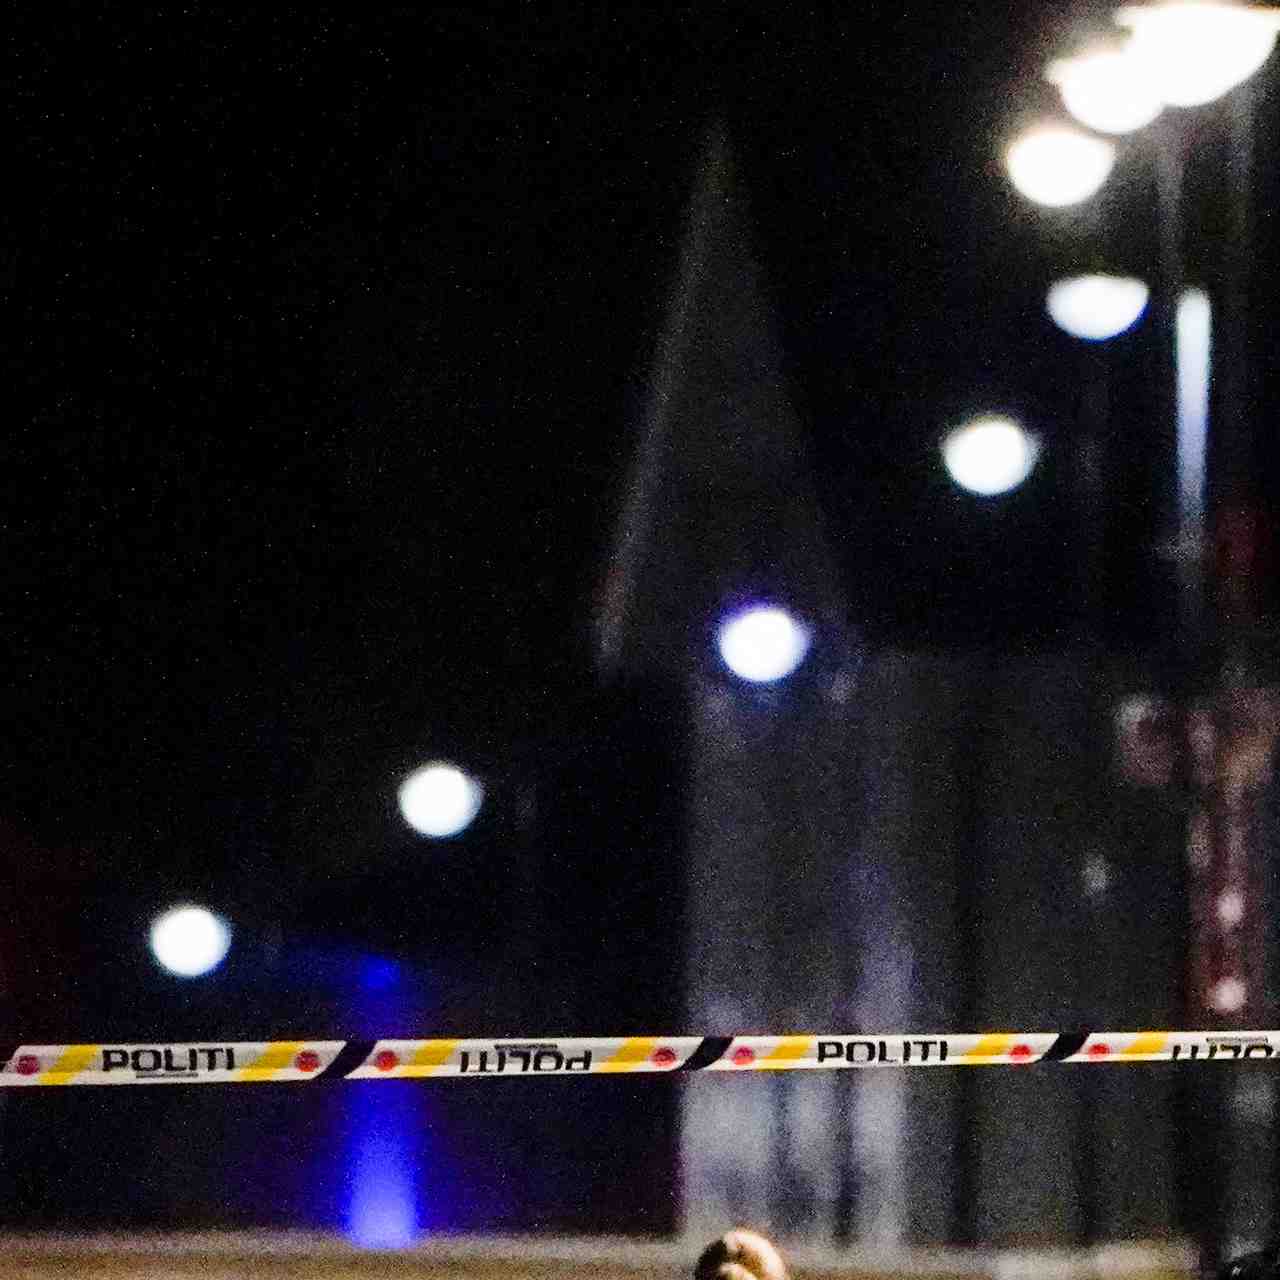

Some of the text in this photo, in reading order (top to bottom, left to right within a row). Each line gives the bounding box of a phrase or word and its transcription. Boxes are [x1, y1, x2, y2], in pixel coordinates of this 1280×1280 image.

[103, 1048, 235, 1073] POLITI
[461, 1050, 592, 1072] POLITI
[817, 1040, 948, 1063] POLITI
